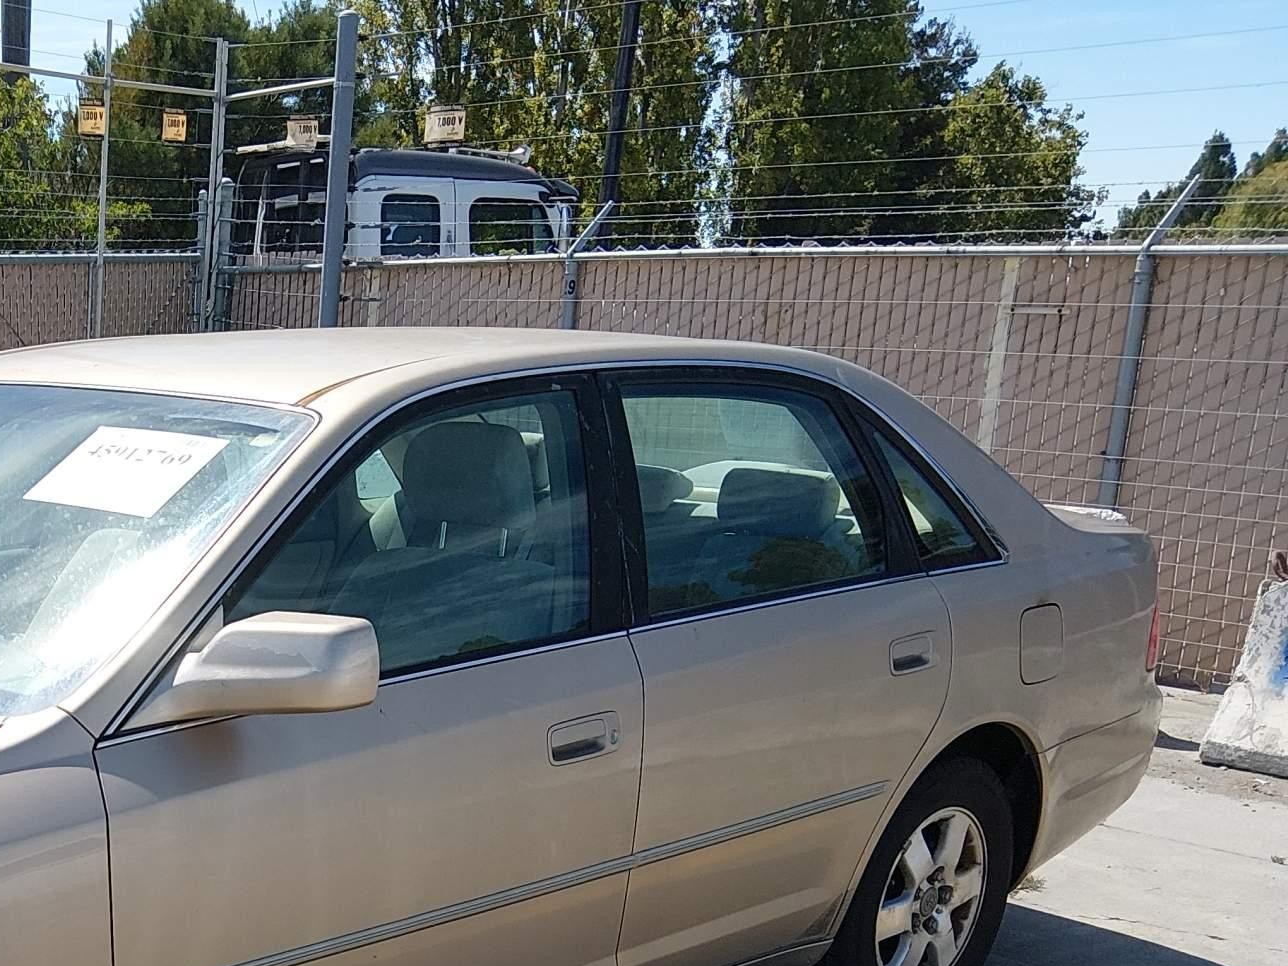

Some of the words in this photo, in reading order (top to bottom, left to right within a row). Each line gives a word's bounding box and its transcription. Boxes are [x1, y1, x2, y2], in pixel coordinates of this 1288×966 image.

[99, 111, 104, 121] V
[437, 115, 456, 128] 7,000
[458, 115, 464, 126] V
